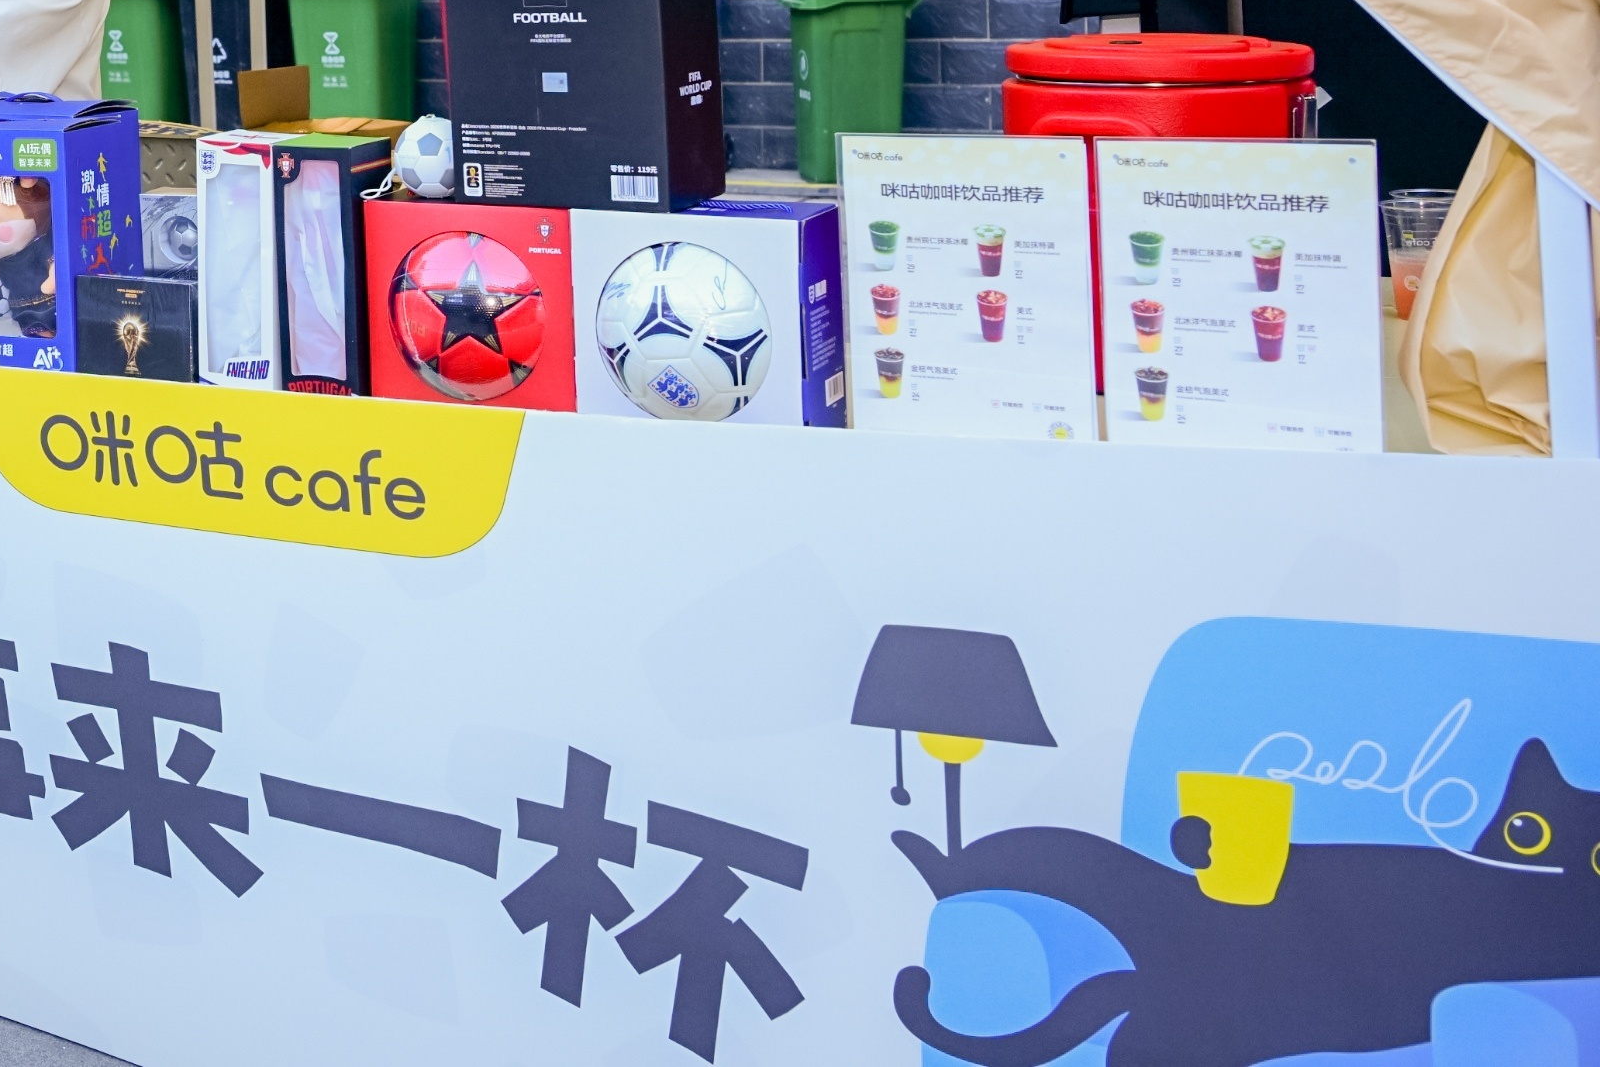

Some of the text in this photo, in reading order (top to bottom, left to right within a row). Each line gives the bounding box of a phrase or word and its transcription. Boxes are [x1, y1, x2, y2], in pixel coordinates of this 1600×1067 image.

[513, 12, 587, 24] FOOTBALL
[688, 71, 701, 82] FIFA
[679, 80, 712, 96] WORLD CUP
[18, 142, 51, 155] AI玩偶
[18, 158, 52, 168] 智享未来
[1148, 158, 1169, 168] cafe
[880, 183, 1044, 204] 咪咕咖啡饮品推荐
[1143, 190, 1330, 213] 咪咕咖啡饮品推荐
[226, 360, 270, 380] ENGLAND
[40, 410, 426, 521] 咪咕 cafe
